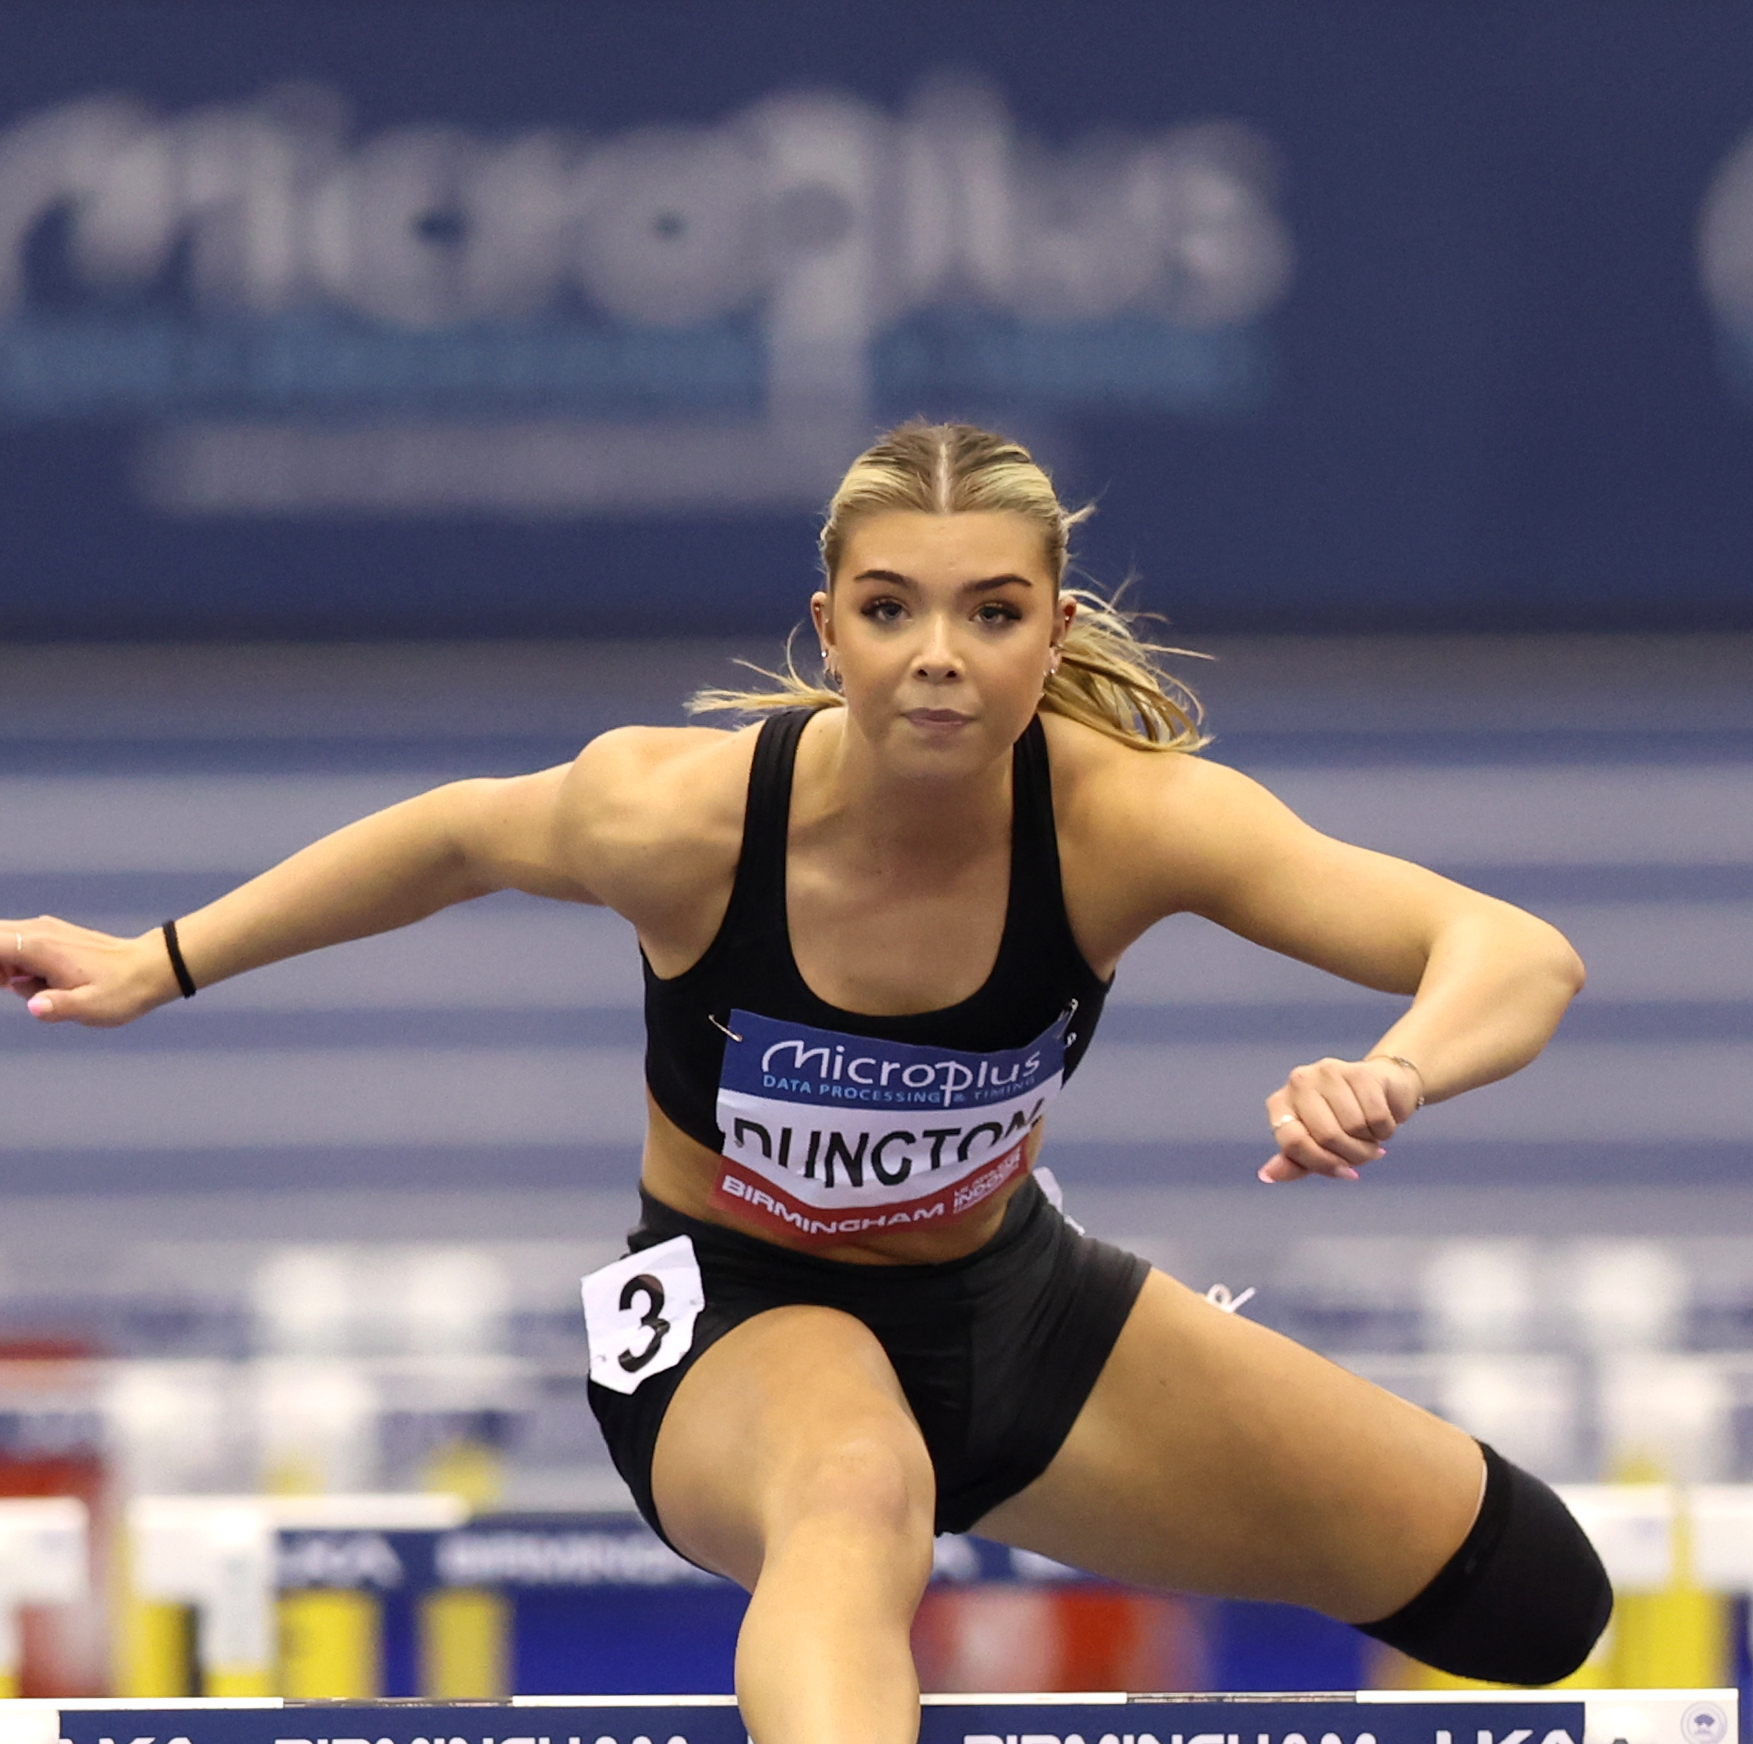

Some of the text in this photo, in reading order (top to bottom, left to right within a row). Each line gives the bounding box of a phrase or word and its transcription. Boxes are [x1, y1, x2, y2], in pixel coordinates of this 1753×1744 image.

[762, 1040, 1040, 1107] Microplus
[763, 1074, 811, 1094] DATA
[820, 1084, 940, 1104] PROCESSING
[721, 1175, 945, 1234] BIRMINGHAM
[619, 1274, 670, 1373] 3
